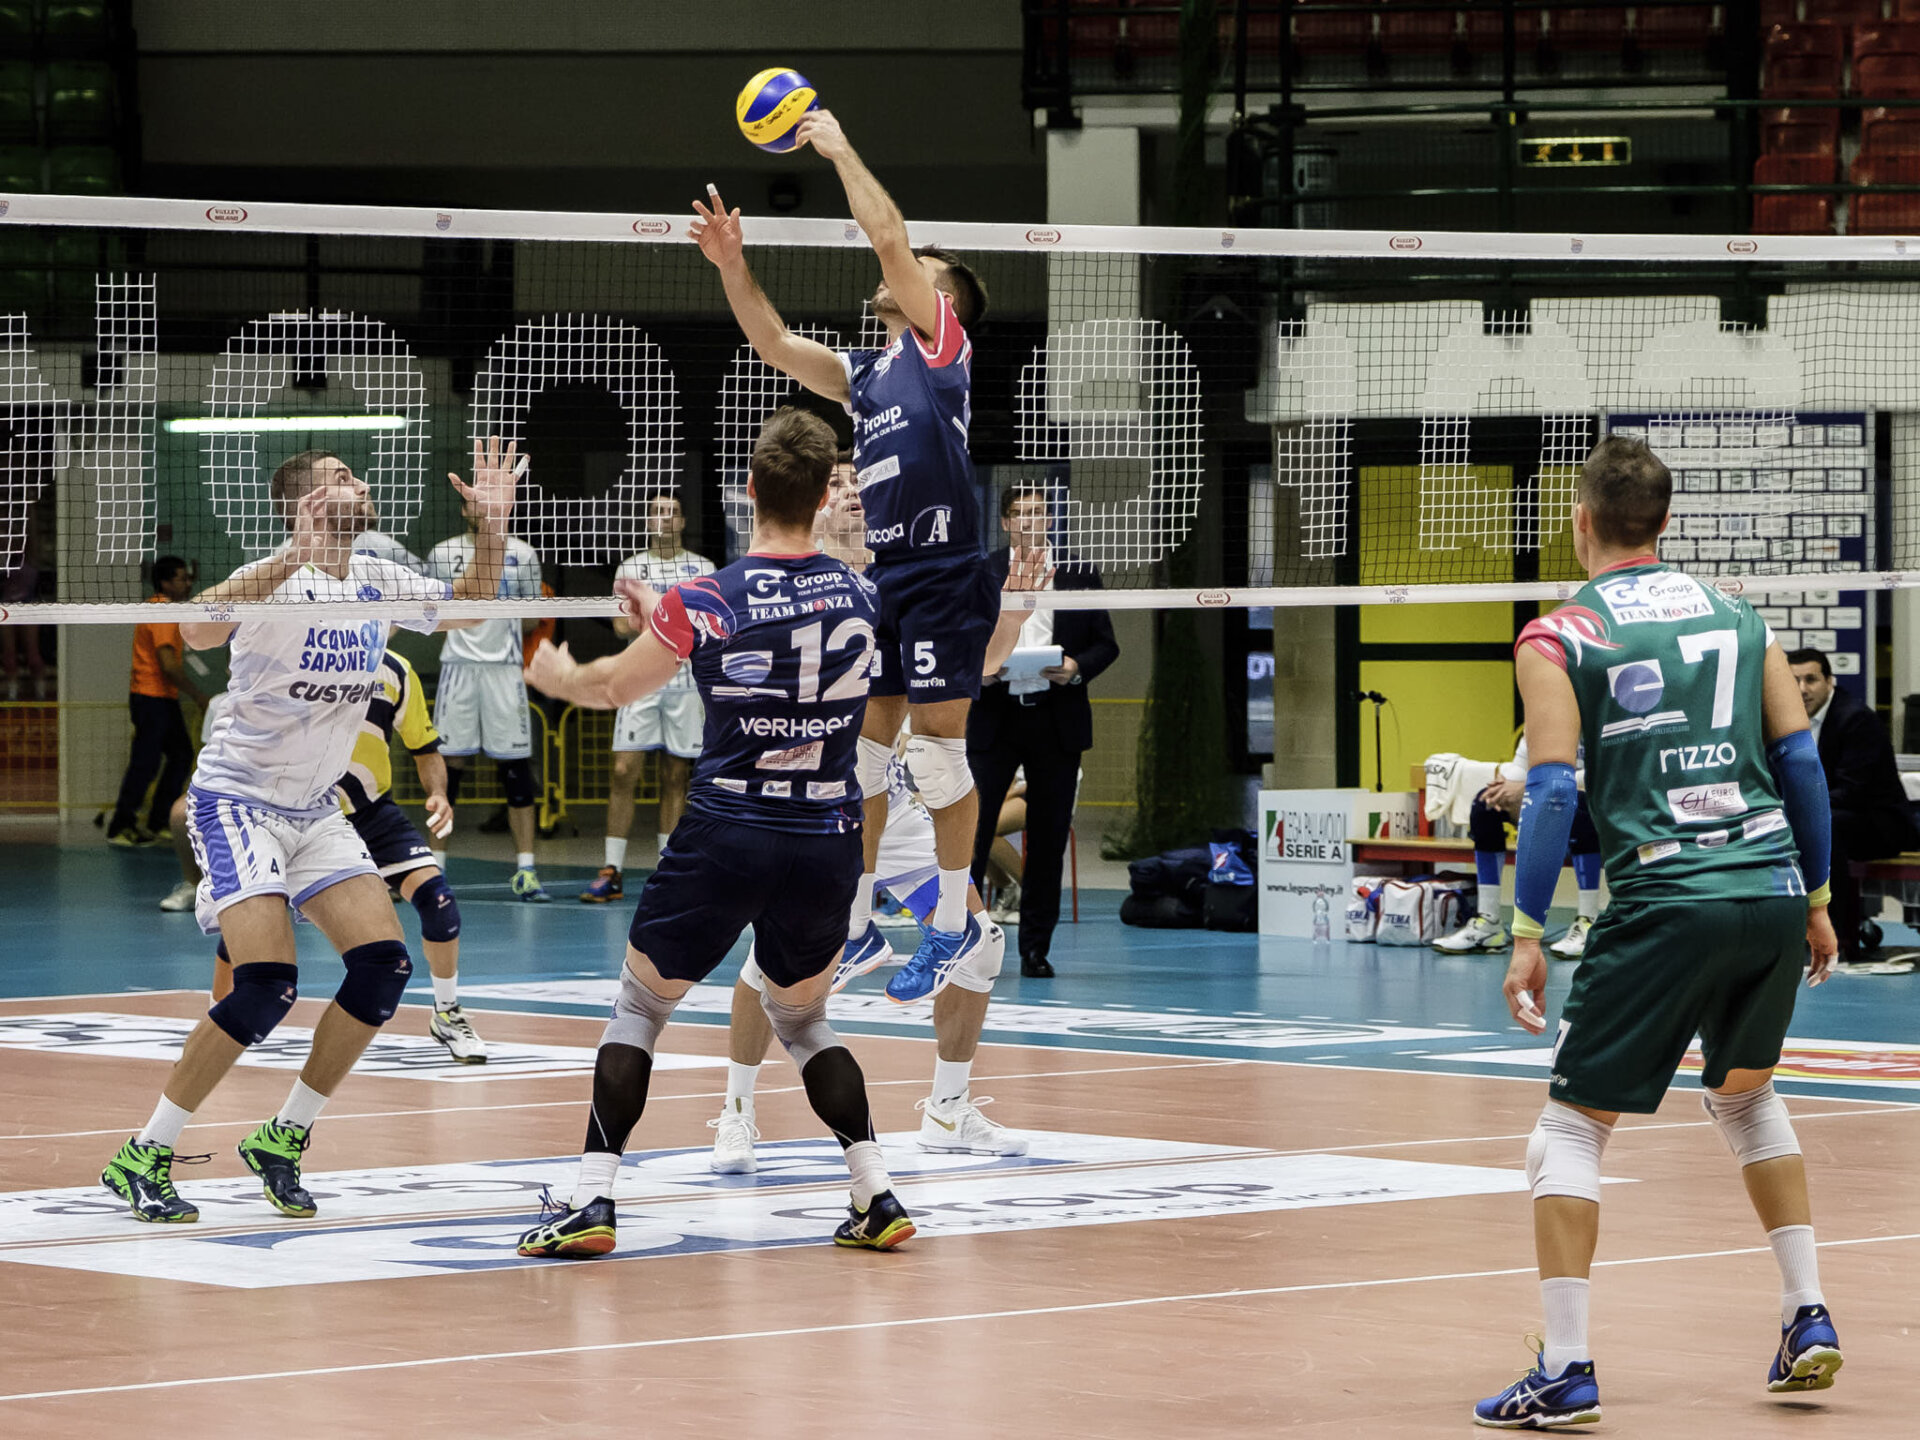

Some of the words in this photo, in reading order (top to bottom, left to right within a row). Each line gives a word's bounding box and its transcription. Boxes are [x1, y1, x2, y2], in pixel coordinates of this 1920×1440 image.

[793, 572, 844, 588] Group
[1648, 584, 1694, 597] Group
[210, 613, 231, 621] VERO
[748, 605, 796, 620] TEAM
[801, 596, 853, 614] MONZA
[1618, 608, 1659, 621] TEAM
[1660, 602, 1710, 618] MONZA
[304, 628, 359, 651] ACQUA
[299, 650, 367, 673] SAPONE
[791, 617, 876, 703] 12
[914, 641, 936, 674] 5
[910, 677, 946, 688] macron
[1677, 629, 1738, 729] 7
[1660, 742, 1737, 774] rizzo
[1286, 844, 1326, 859] SERIE
[1331, 846, 1342, 860] A
[270, 858, 280, 876] 4
